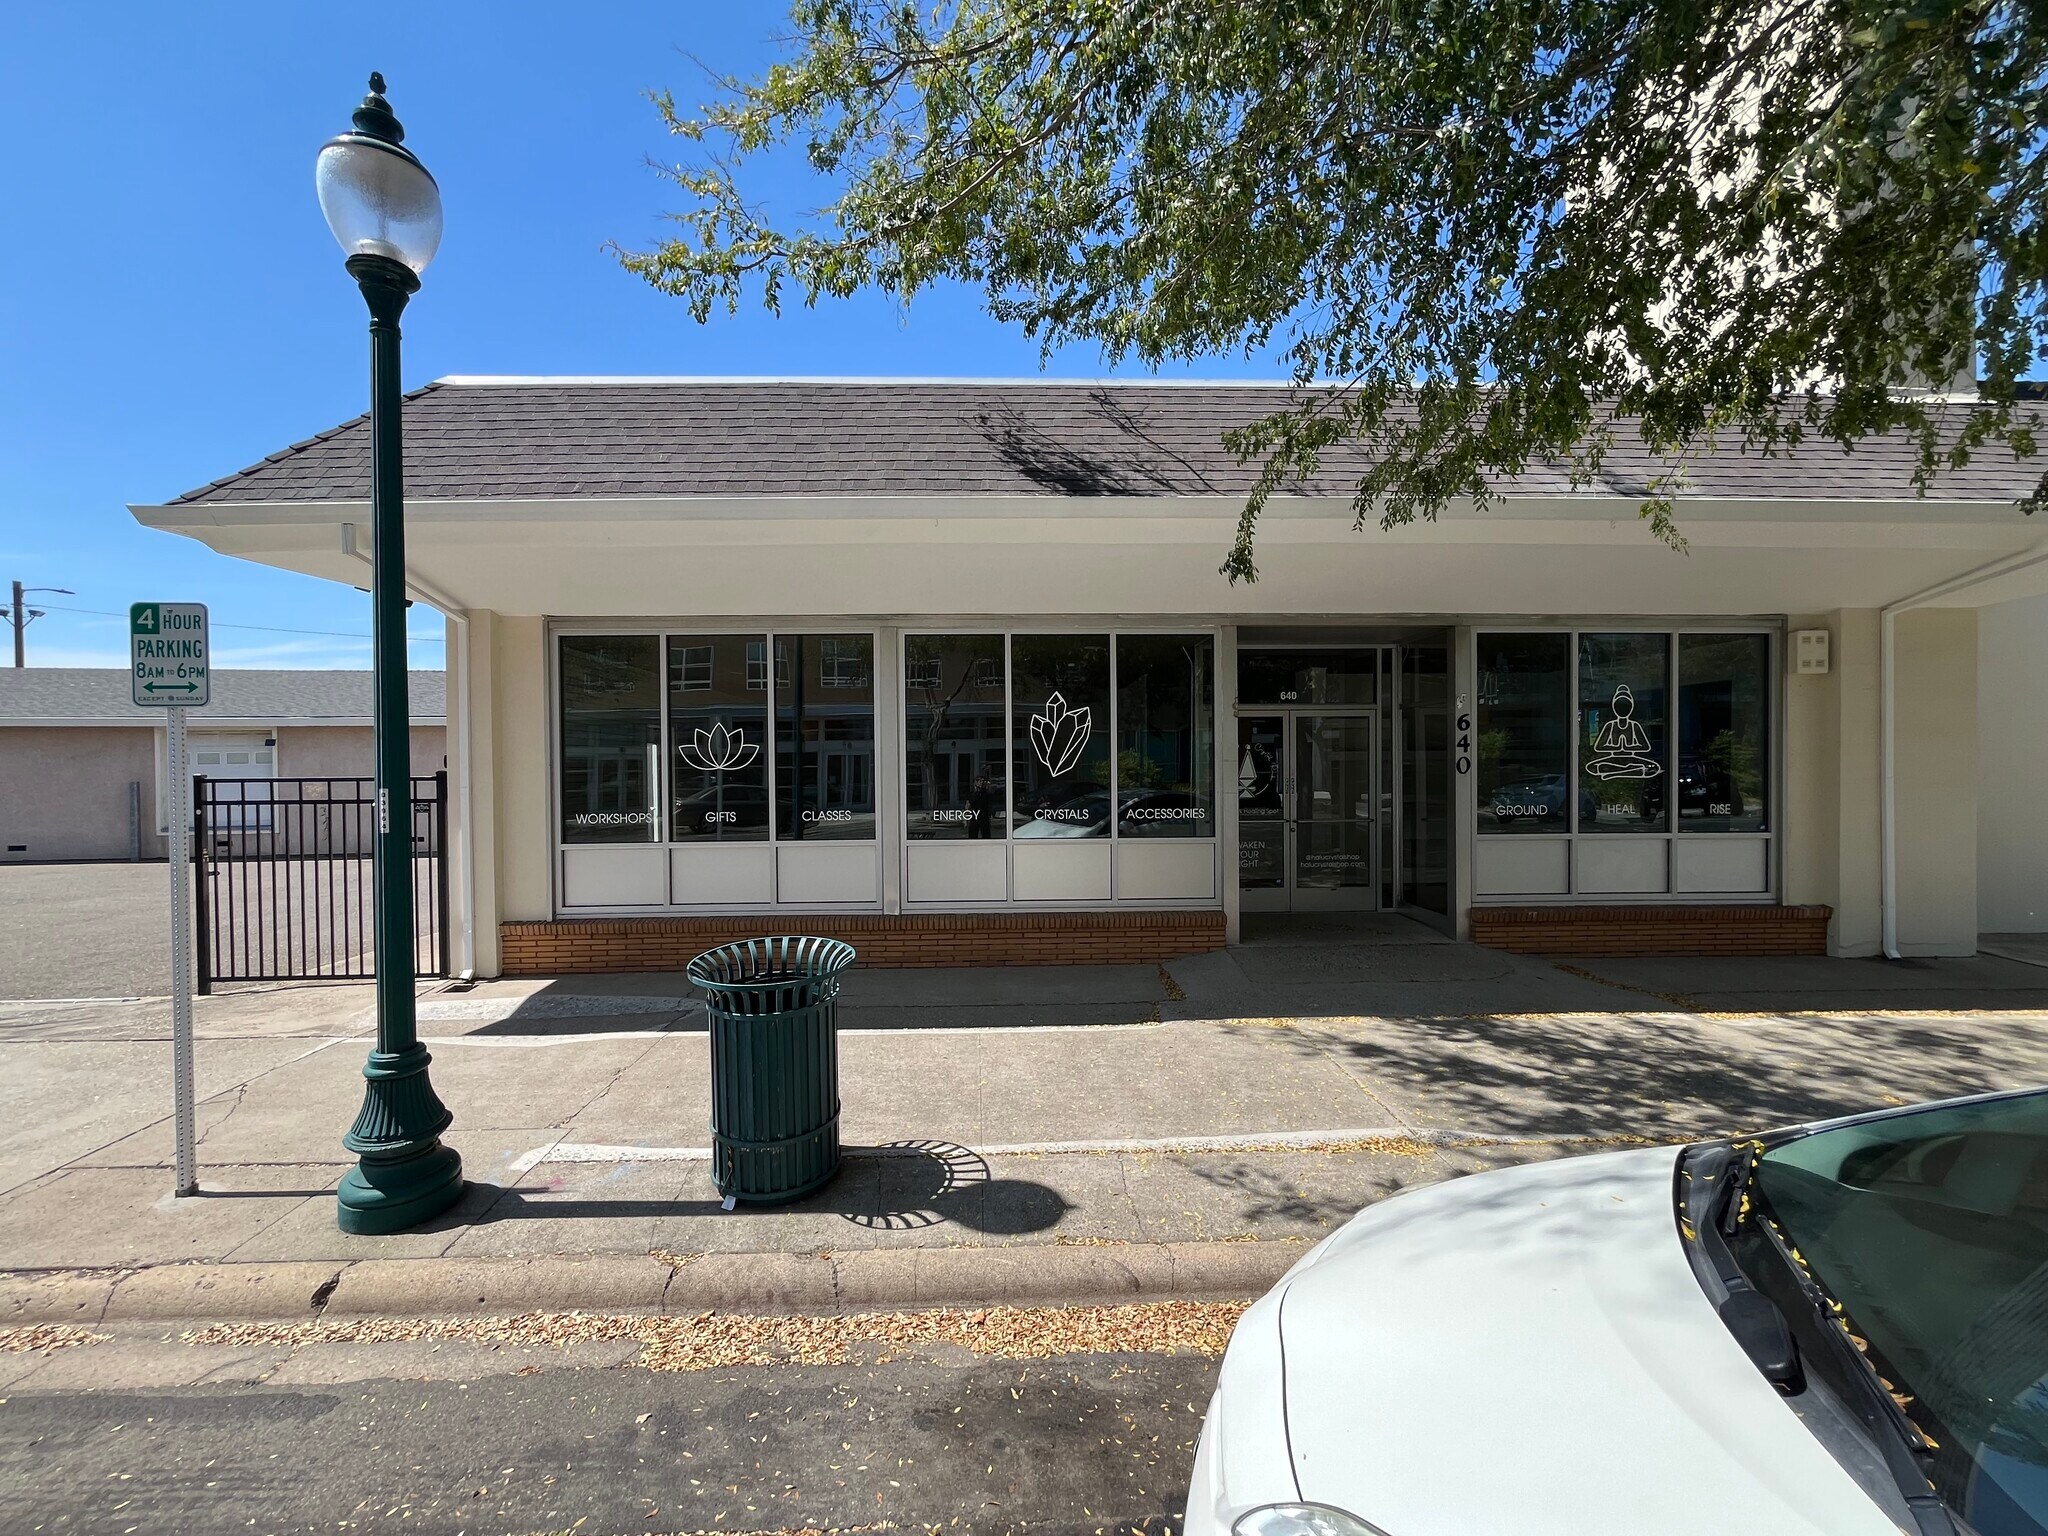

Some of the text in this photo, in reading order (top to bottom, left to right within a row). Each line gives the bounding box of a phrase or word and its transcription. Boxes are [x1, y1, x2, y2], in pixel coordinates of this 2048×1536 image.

[136, 608, 202, 629] 4 HOUR
[137, 640, 203, 658] PARKING
[136, 662, 164, 678] 8AM
[177, 662, 205, 678] 6PM
[1280, 692, 1297, 700] 640
[1456, 713, 1471, 775] 640
[1034, 808, 1089, 820] CRYSTALS
[1126, 808, 1205, 819] ACCESSORIES
[1496, 805, 1548, 816] GROUND
[1607, 804, 1636, 815] HEAL
[1709, 804, 1731, 815] RISE
[576, 813, 653, 824] WORKSHOPS
[705, 811, 737, 823] GIFTS
[801, 810, 852, 822] CLASSES
[933, 810, 981, 821] ENERGY
[1240, 850, 1259, 859] OUR
